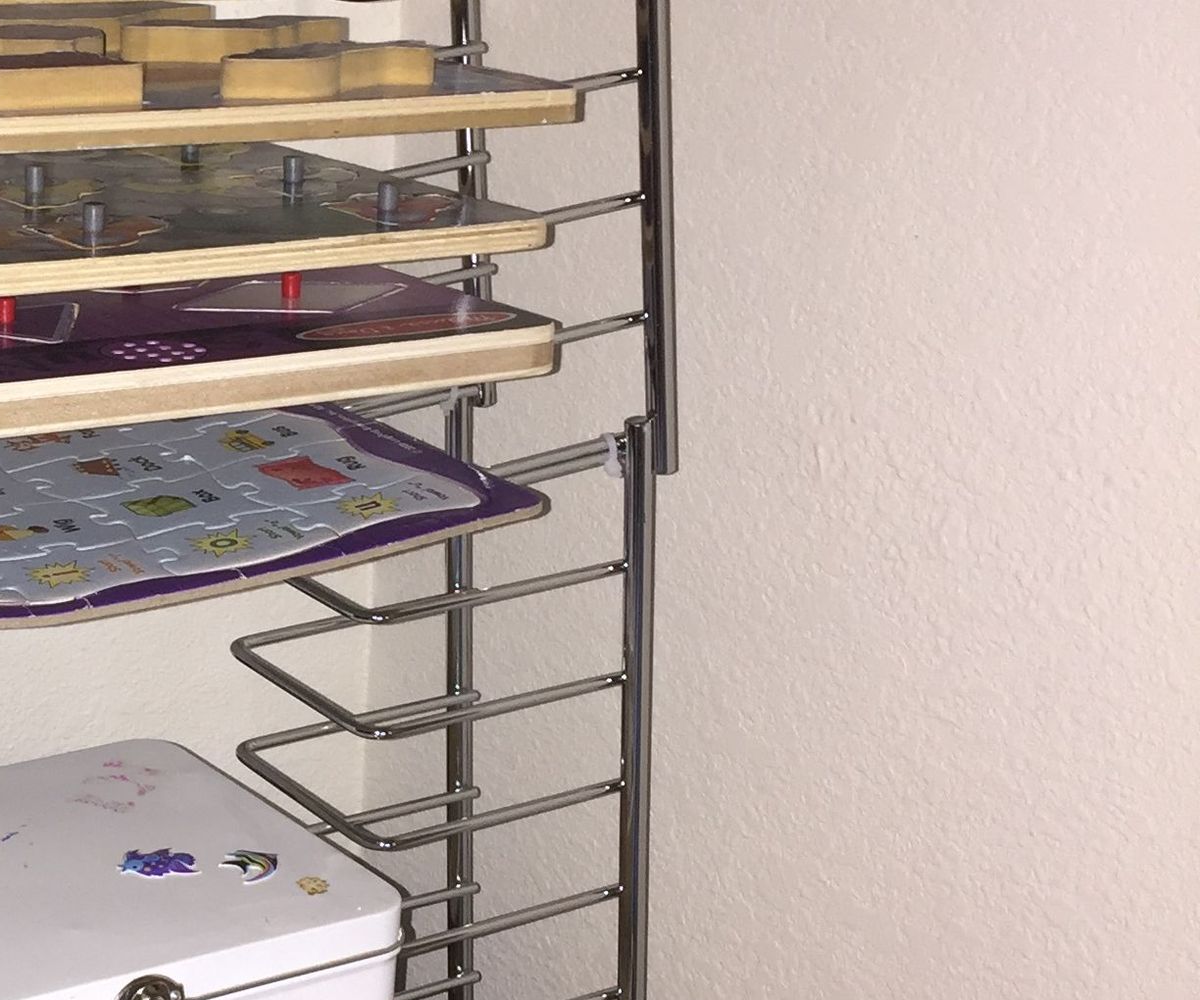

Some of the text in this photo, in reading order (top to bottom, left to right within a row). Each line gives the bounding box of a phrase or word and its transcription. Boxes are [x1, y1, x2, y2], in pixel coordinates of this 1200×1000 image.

[128, 455, 163, 472] Dock
[336, 455, 365, 471] Rug
[192, 488, 221, 503] Box
[52, 518, 81, 533] Wig
